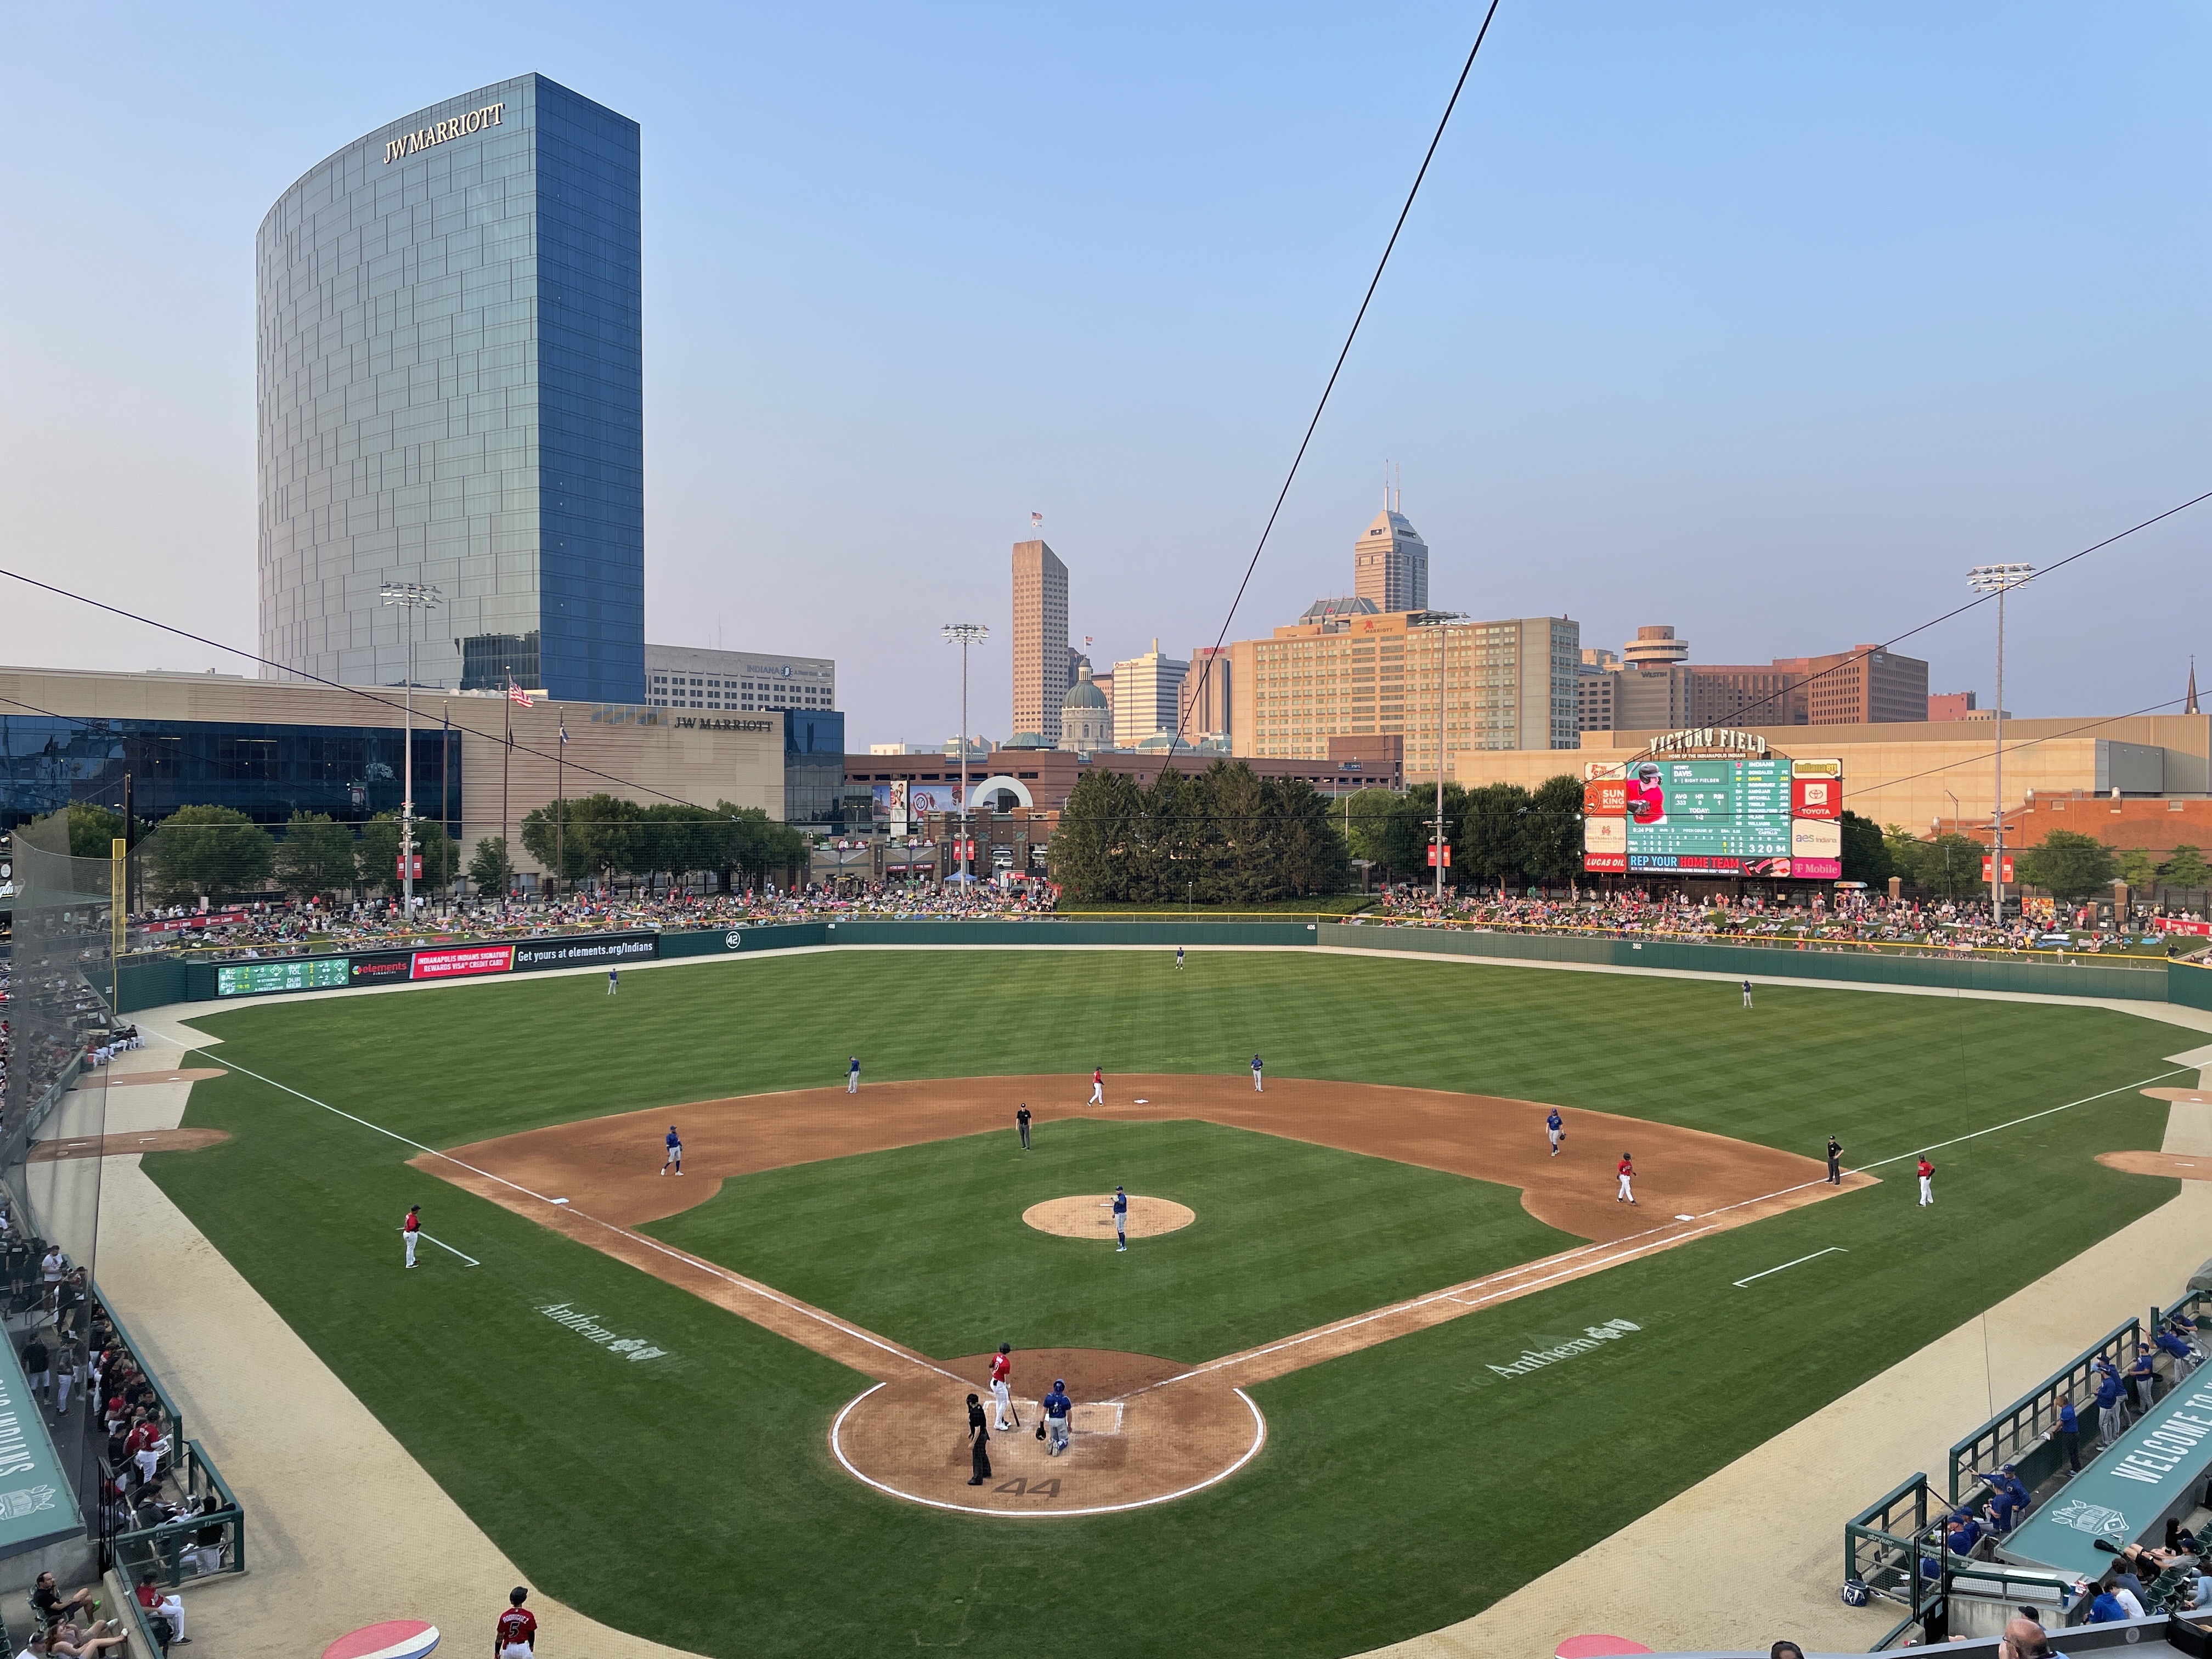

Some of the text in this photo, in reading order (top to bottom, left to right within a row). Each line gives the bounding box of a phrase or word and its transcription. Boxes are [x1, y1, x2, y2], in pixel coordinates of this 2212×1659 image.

[384, 103, 505, 164] JW MARRIOTT
[747, 664, 780, 674] INDIANA
[675, 717, 773, 732] JW MARRIOTT
[1650, 728, 1767, 755] VICTORY FIELD
[1603, 789, 1624, 798] SUN
[1749, 844, 1756, 853] 3
[1758, 844, 1764, 853] 2
[1767, 844, 1773, 853] 0
[1630, 855, 1739, 868] REP YOUR HOME TEAM
[1795, 864, 1837, 873] T Mobile
[727, 934, 738, 945] 42
[418, 951, 509, 965] INDIANAPOLIS INDIANS SIGNATURE
[518, 942, 653, 962] Get yours at elements.org/Indians
[363, 962, 407, 973] elements
[424, 963, 451, 973] REWARDS
[533, 1302, 616, 1343] Anthem
[1485, 1338, 1606, 1380] Anthem
[2111, 1411, 2212, 1483] WELCOME
[991, 1477, 1062, 1498] 44
[1867, 1533, 1894, 1546] stryker
[1920, 1549, 1942, 1560] ryker
[509, 1621, 520, 1638] 5
